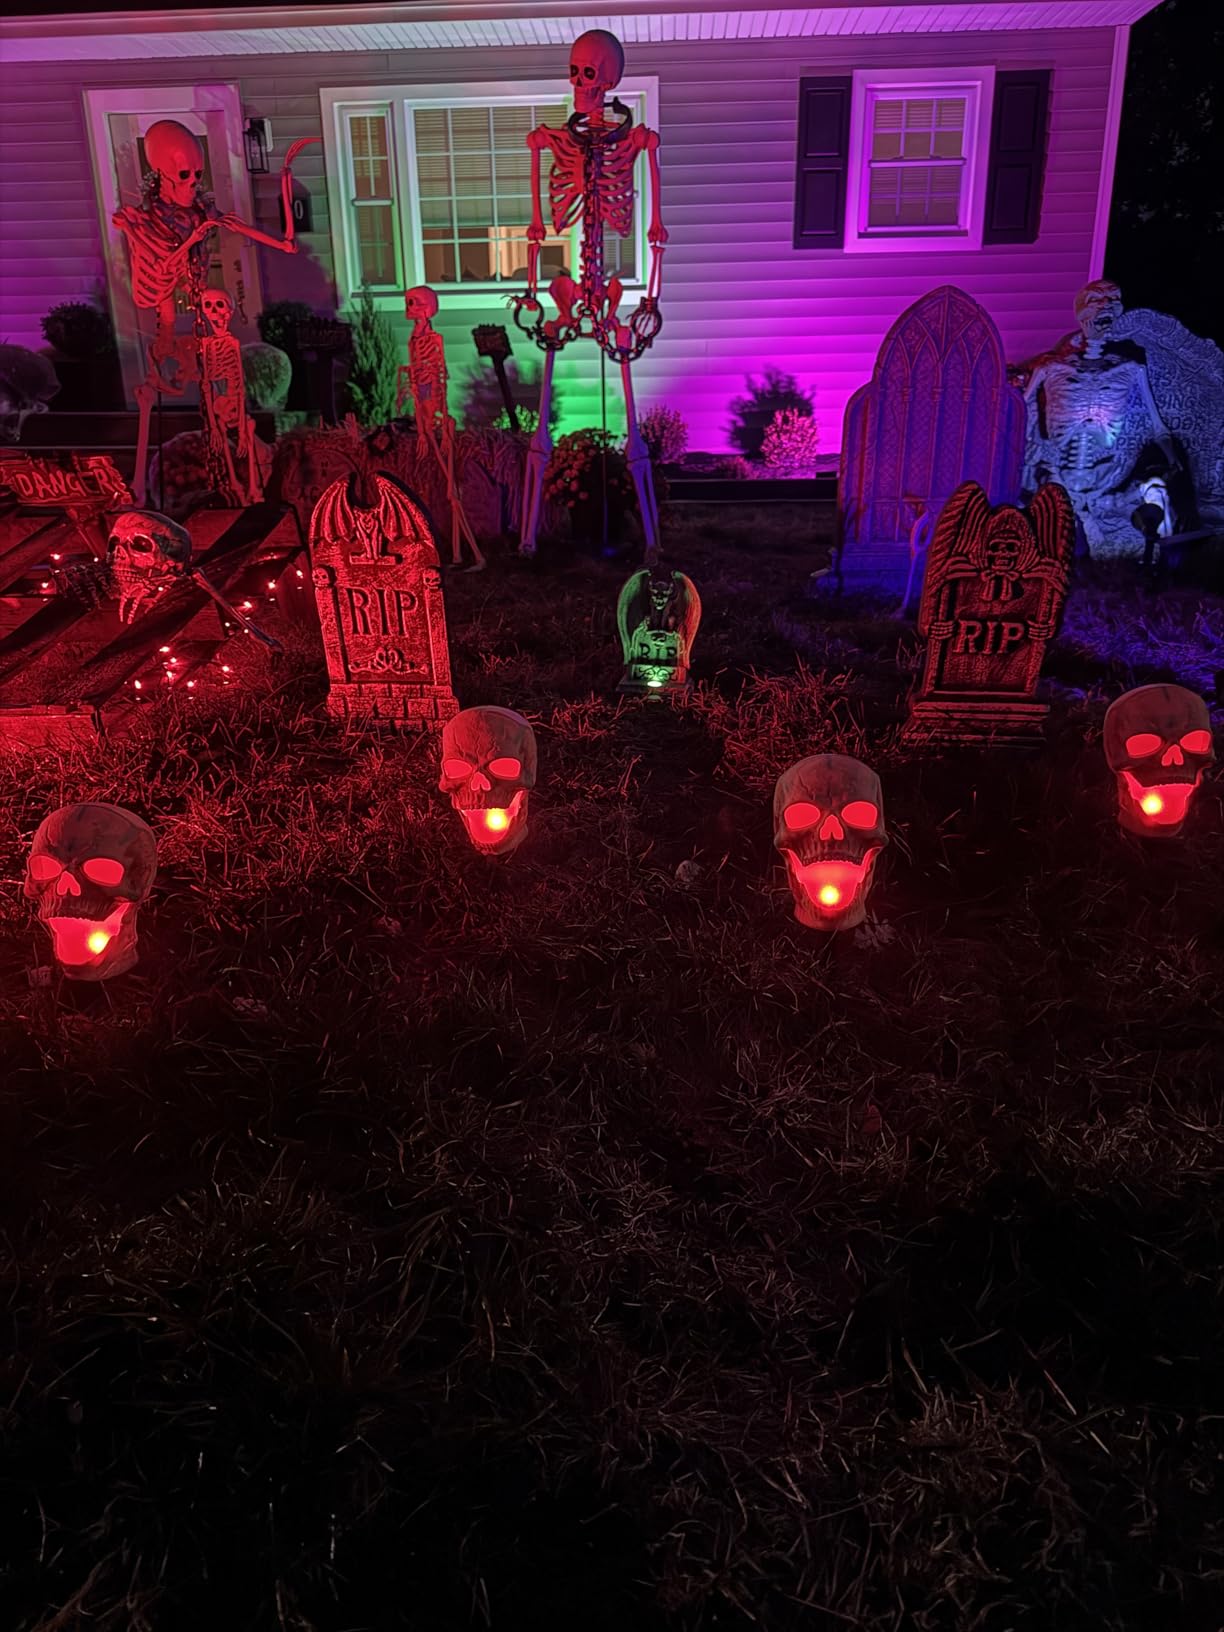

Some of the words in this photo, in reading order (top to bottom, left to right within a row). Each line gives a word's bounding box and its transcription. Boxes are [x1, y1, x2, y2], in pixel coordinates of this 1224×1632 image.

[15, 468, 116, 498] DANGER
[345, 587, 418, 637] RIP
[638, 642, 678, 660] RIP
[952, 620, 1025, 655] RIP
